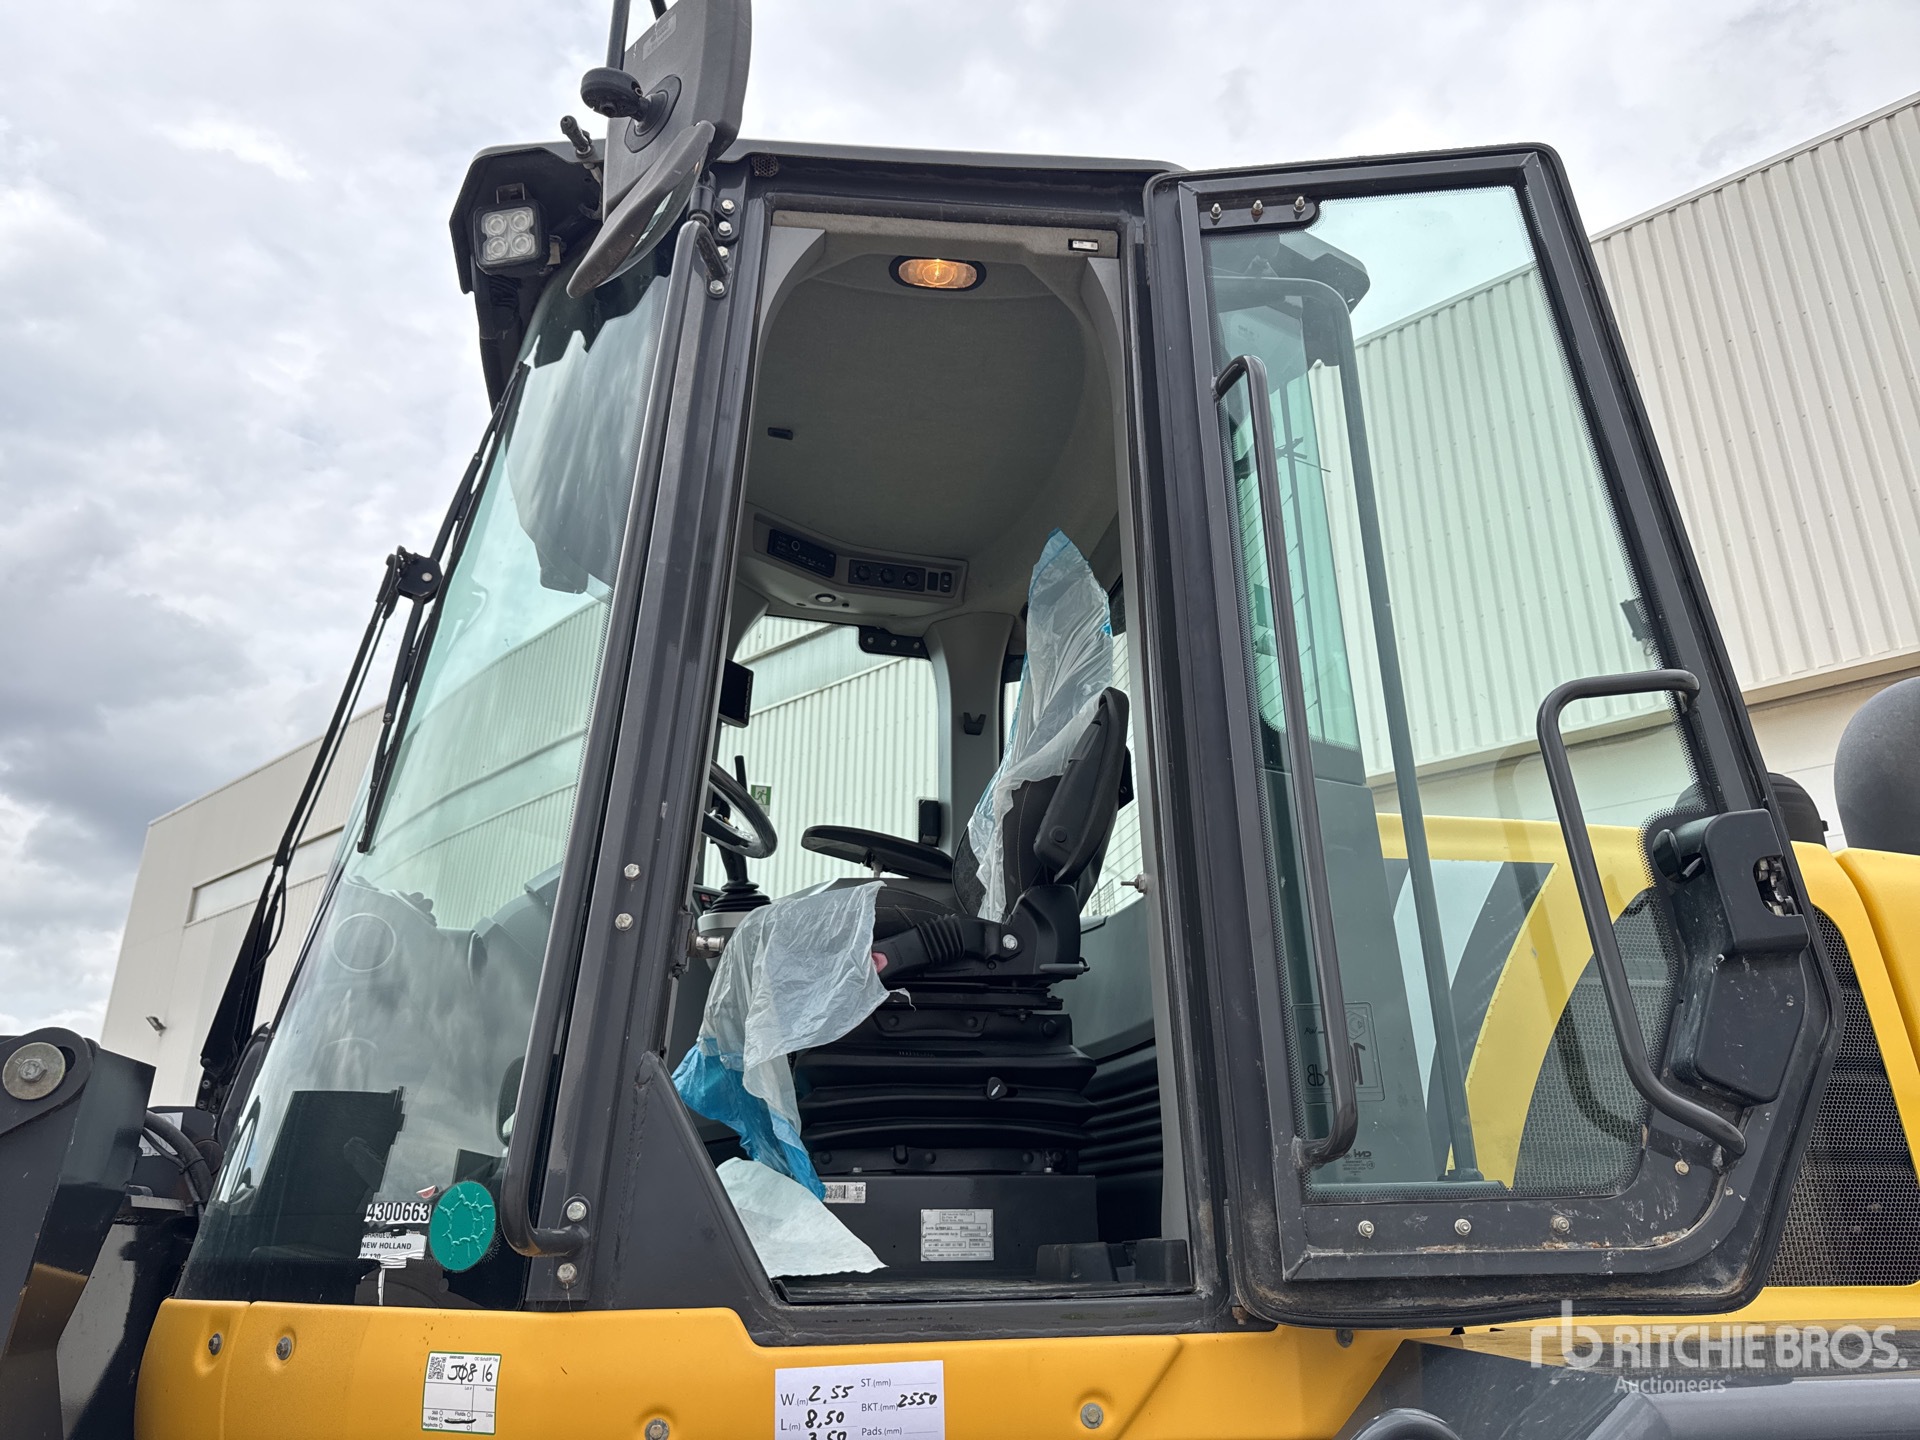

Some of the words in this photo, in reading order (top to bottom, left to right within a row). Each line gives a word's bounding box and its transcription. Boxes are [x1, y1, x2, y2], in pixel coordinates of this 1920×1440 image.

[366, 1202, 430, 1221] 4300663
[482, 1363, 493, 1382] 16
[897, 1391, 938, 1408] 2550
[805, 1409, 845, 1429] 8,50
